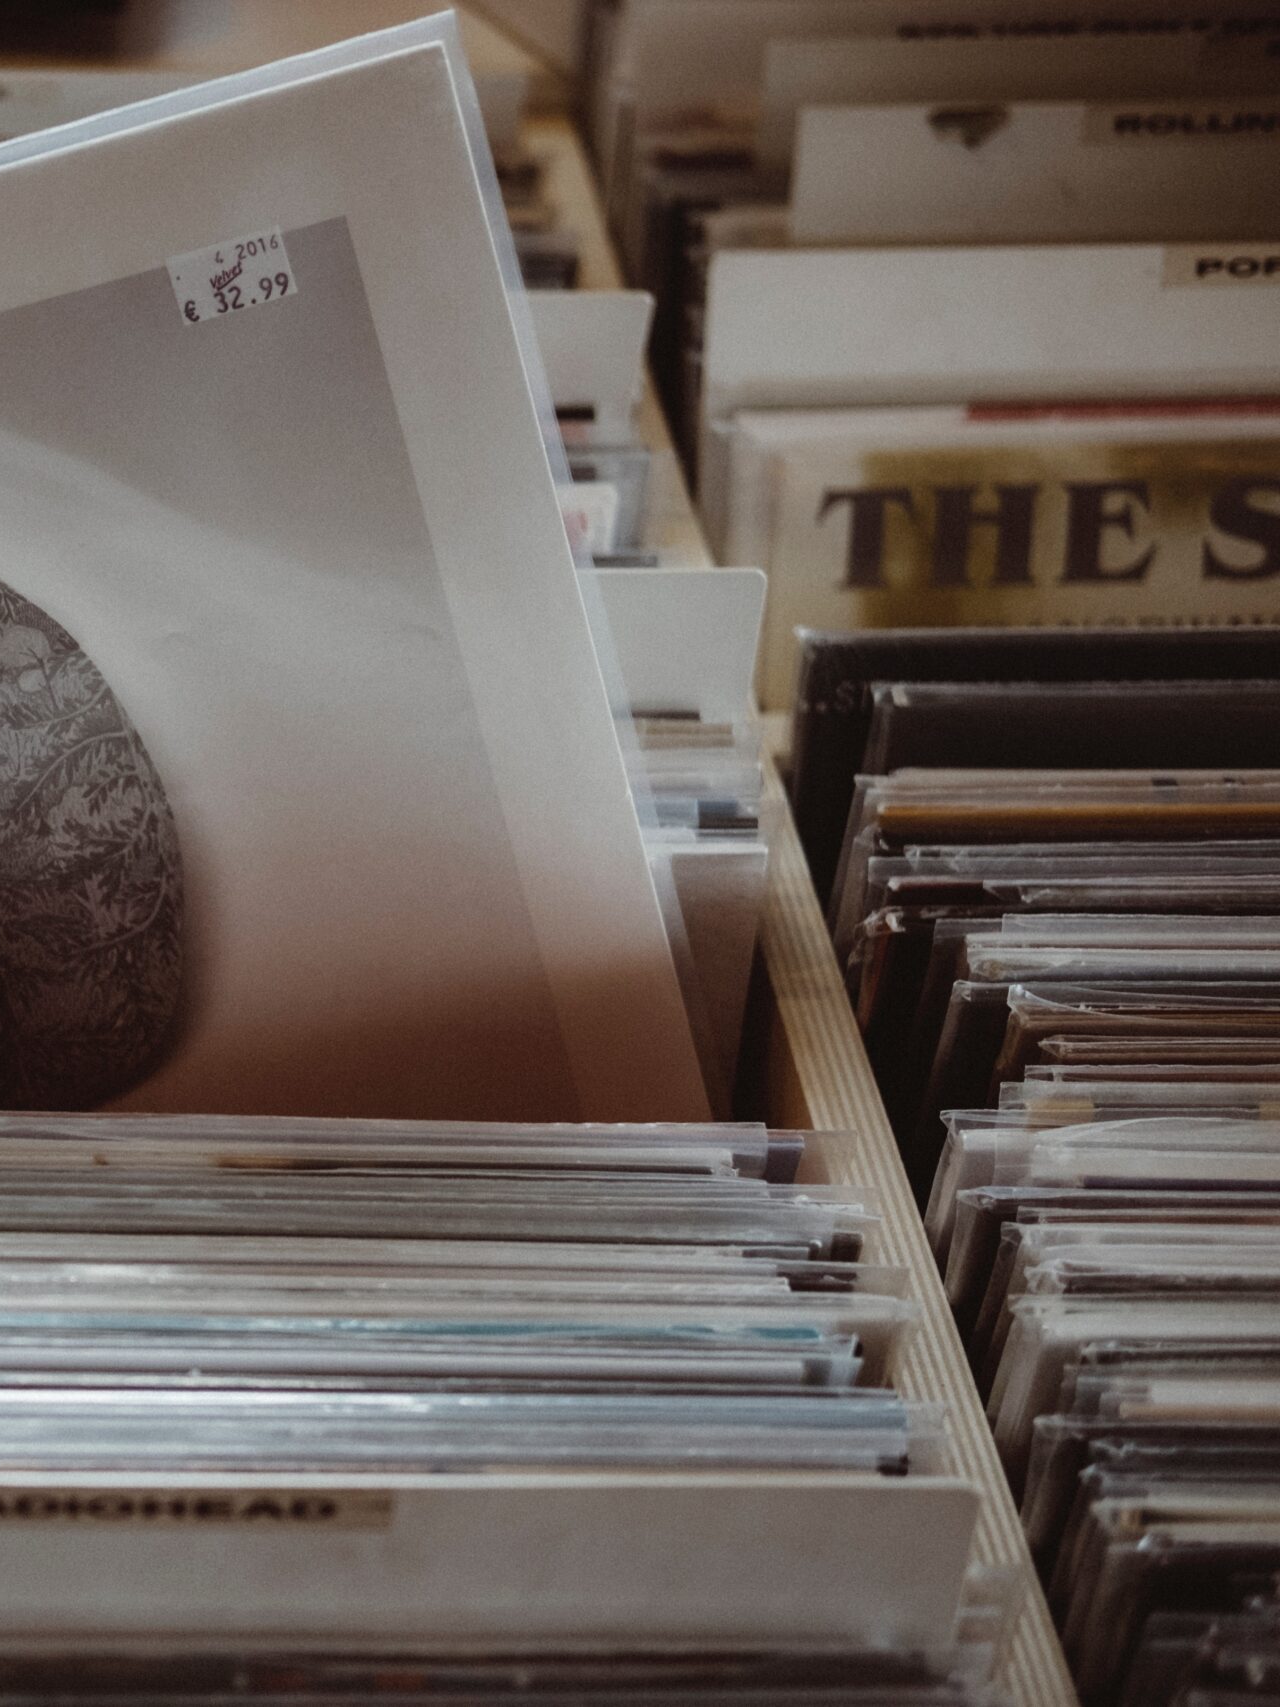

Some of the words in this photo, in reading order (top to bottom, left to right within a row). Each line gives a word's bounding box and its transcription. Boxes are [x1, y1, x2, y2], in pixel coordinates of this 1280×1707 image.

[235, 234, 279, 261] 2016
[209, 262, 243, 291] Velvet
[184, 299, 200, 322] €
[212, 272, 290, 313] 32.99
[814, 478, 1157, 590] THE
[1201, 471, 1280, 583] S
